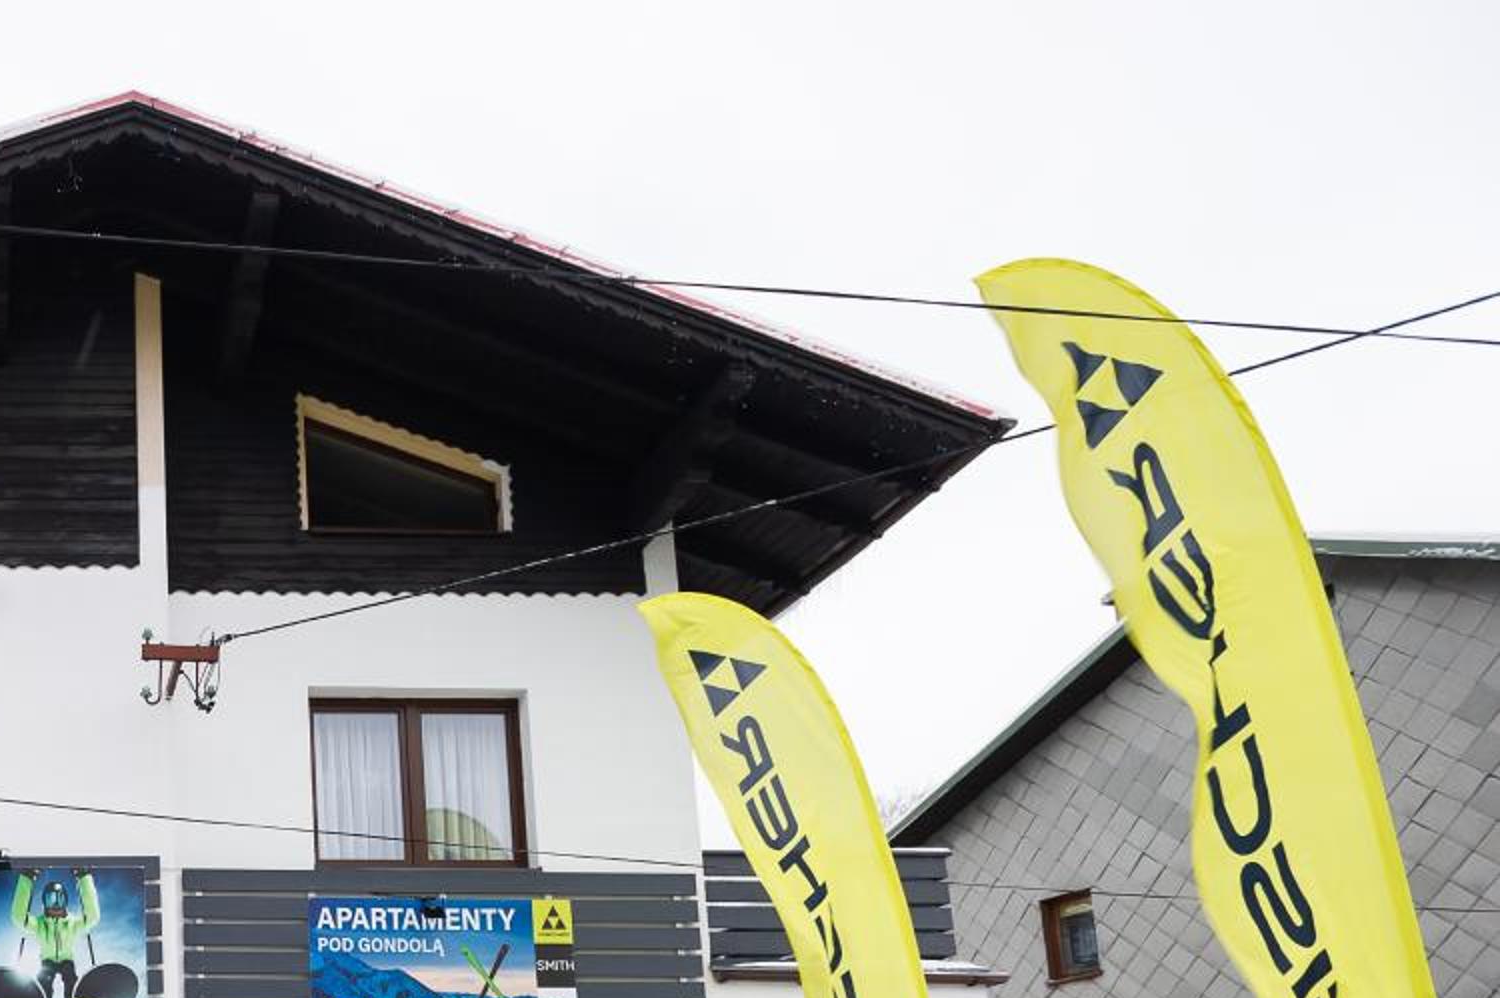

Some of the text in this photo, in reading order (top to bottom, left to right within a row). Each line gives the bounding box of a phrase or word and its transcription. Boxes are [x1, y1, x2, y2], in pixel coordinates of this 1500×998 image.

[317, 907, 516, 932] APARTAMENTY
[317, 937, 445, 957] POD GONDOLĄ
[536, 959, 575, 972] SMITH
